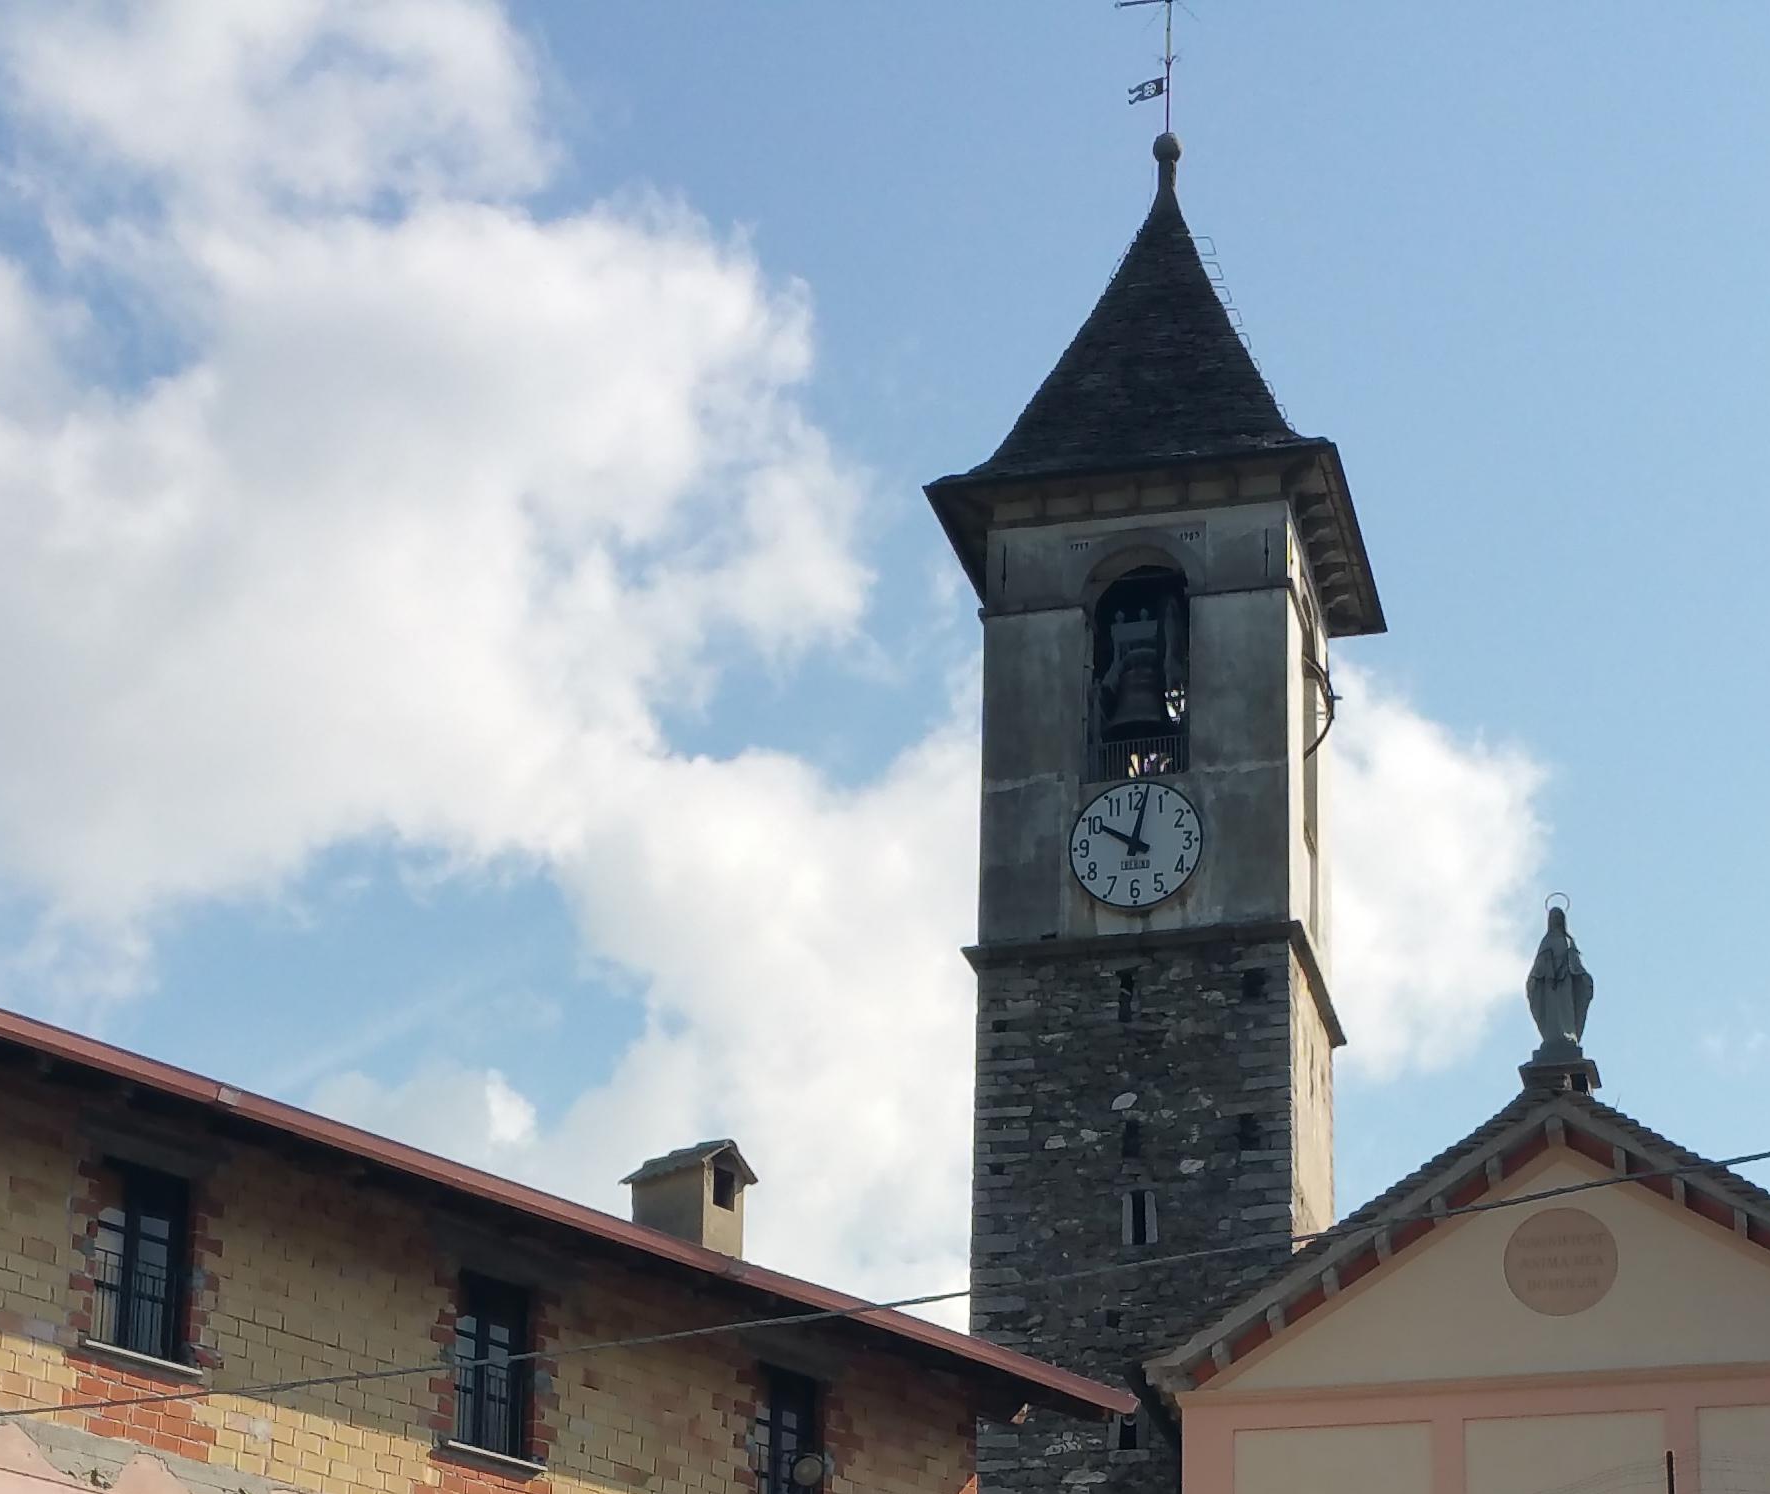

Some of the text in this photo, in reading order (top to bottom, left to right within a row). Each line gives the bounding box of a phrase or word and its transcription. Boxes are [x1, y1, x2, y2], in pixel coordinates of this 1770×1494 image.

[1109, 798, 1120, 817] 11
[1128, 791, 1143, 811] 12
[1158, 794, 1163, 813] 1
[1088, 816, 1103, 835] 10
[1174, 809, 1184, 828] 2
[1079, 839, 1090, 858] 9
[1182, 831, 1192, 850] 3
[1087, 861, 1097, 881] 8
[1174, 854, 1185, 874] 4
[1107, 876, 1117, 896] 7
[1130, 879, 1140, 898] 6
[1153, 873, 1164, 892] 5
